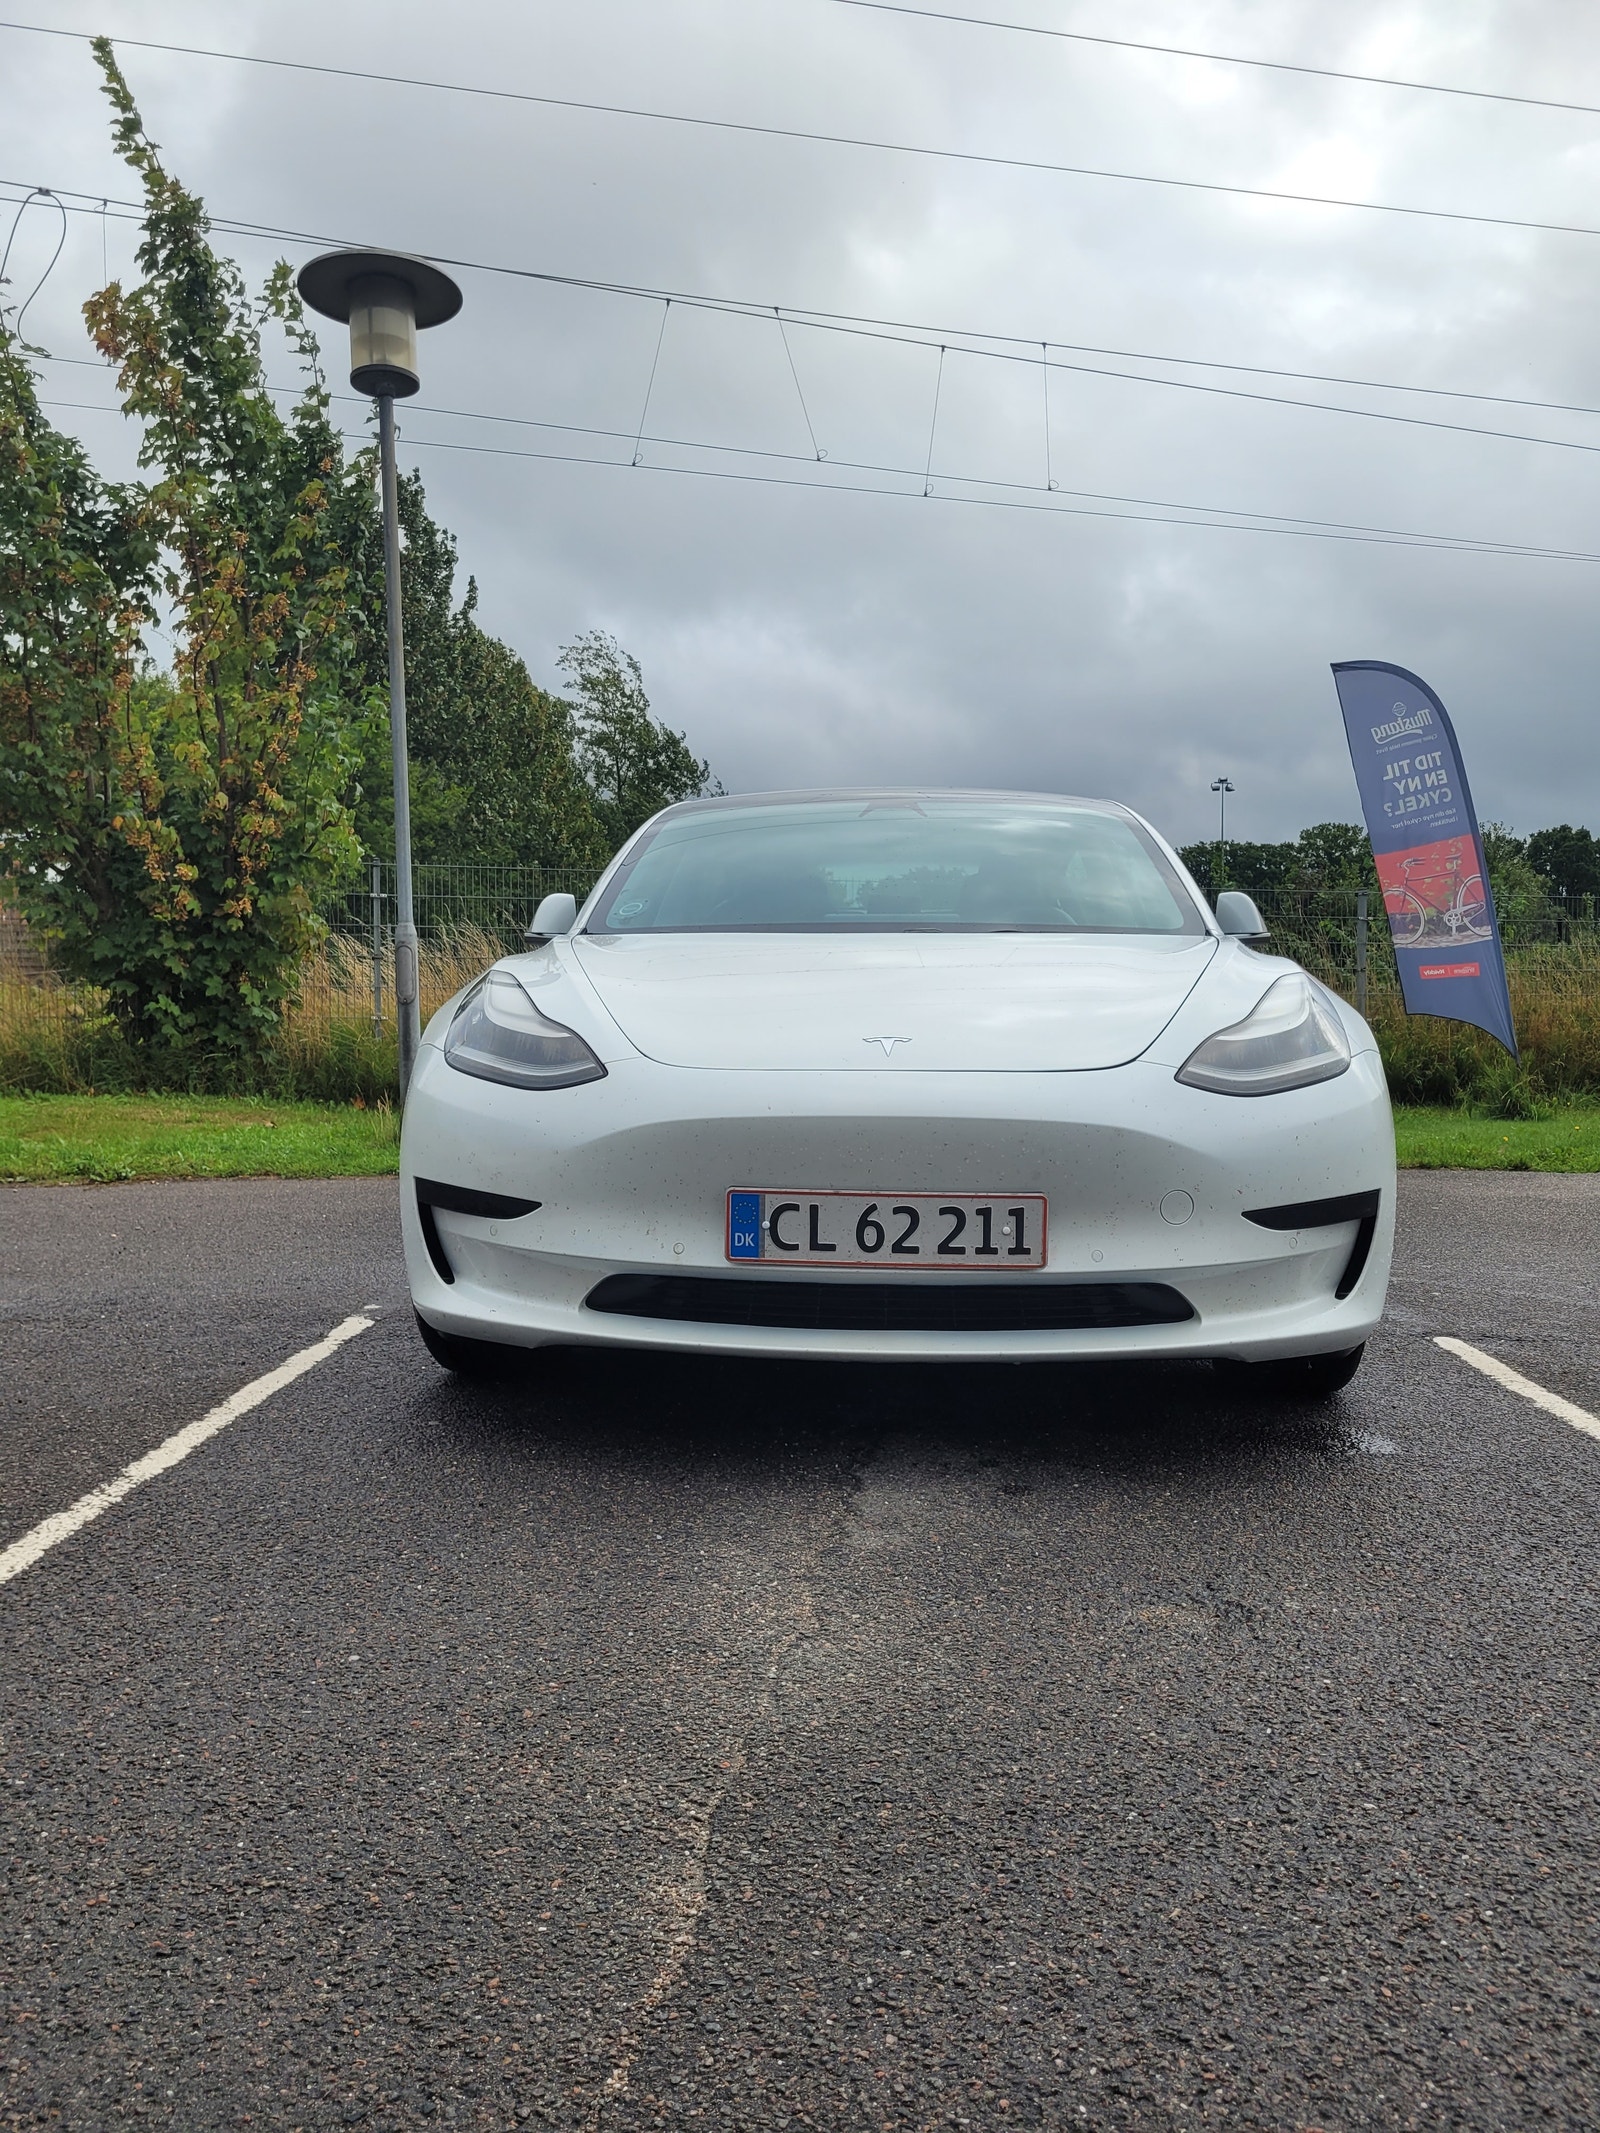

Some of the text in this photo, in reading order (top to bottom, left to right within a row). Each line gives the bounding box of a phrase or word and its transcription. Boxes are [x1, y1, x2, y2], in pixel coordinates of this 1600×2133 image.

[734, 1232, 755, 1247] DK
[769, 1202, 1031, 1255] CL 62 211
